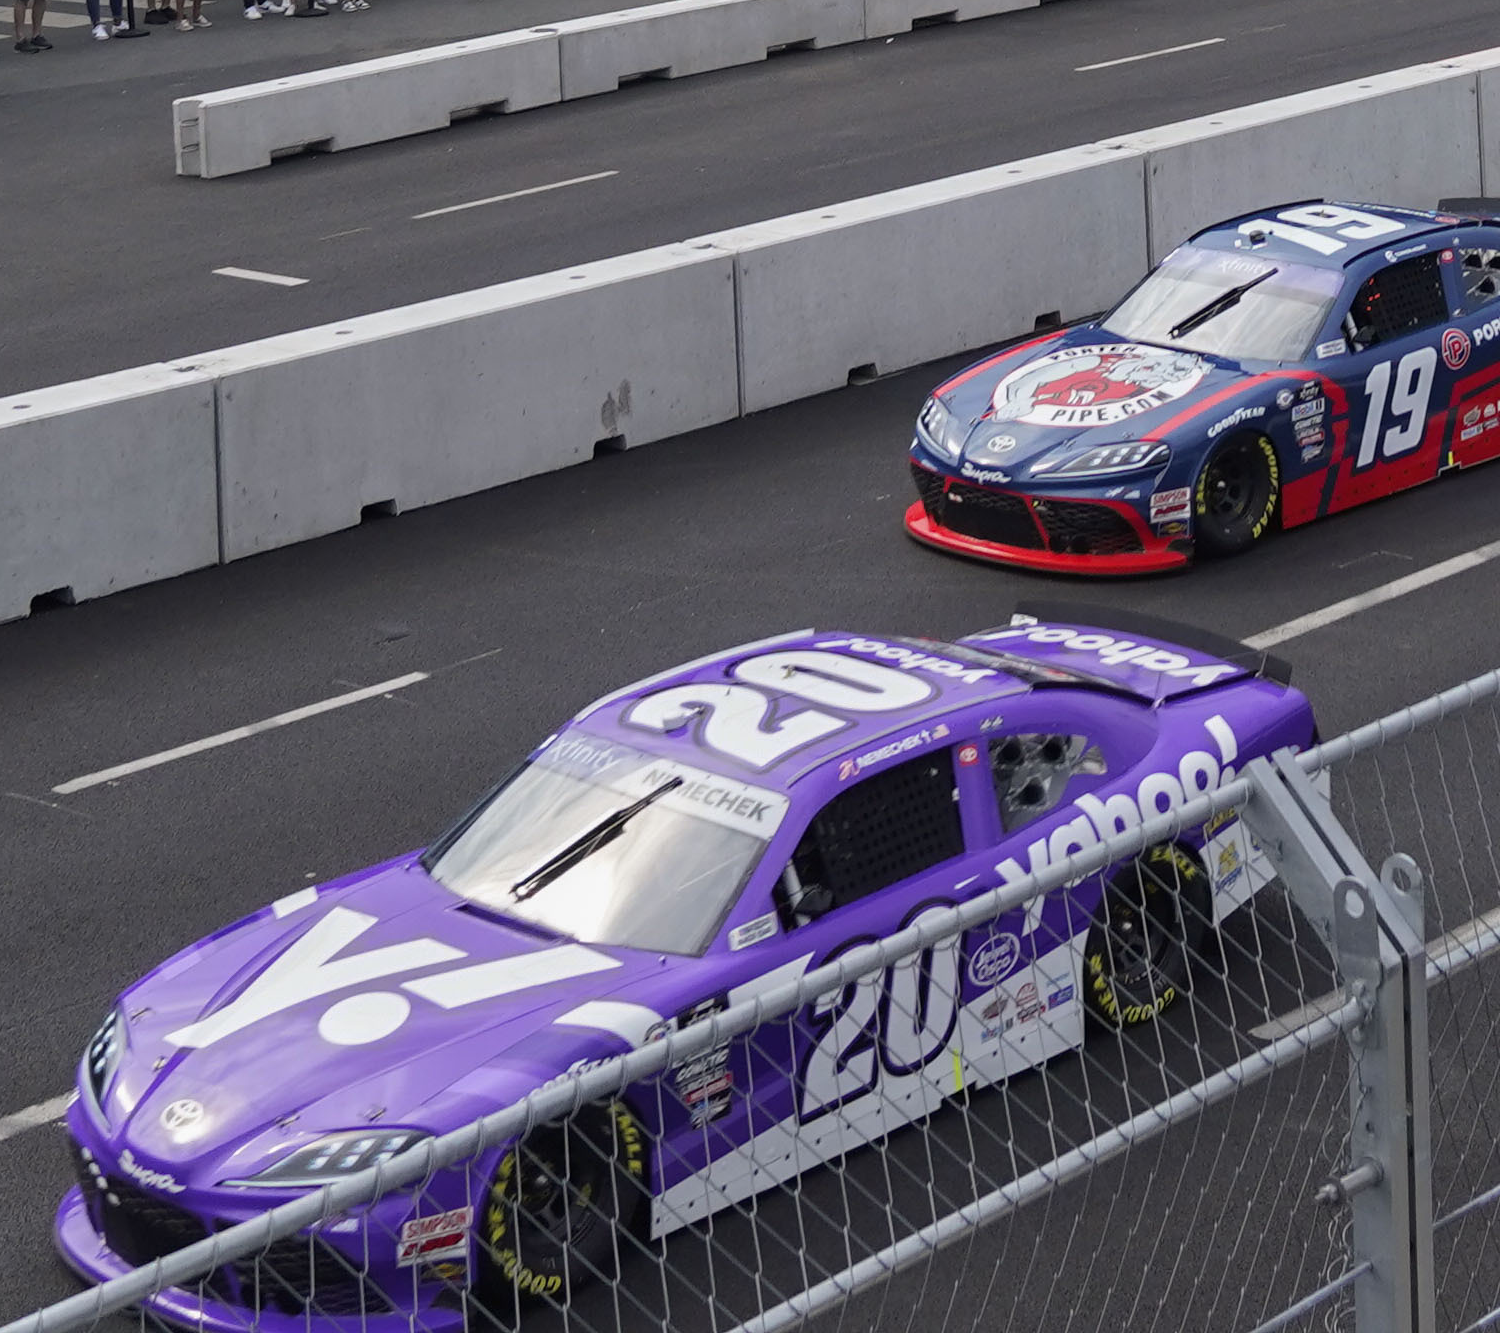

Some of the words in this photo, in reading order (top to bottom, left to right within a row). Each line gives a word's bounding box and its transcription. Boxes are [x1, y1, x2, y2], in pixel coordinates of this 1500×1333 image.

[1237, 204, 1406, 256] 19
[1050, 345, 1138, 360] PORTER
[1050, 390, 1174, 422] PIPE.COM
[1207, 406, 1266, 438] GOODYEAR
[1356, 345, 1438, 469] 19
[961, 461, 1013, 484] Supra
[1153, 487, 1188, 506] SIMPSON
[813, 636, 999, 685] yahoo!
[622, 649, 938, 769] 20
[550, 736, 618, 770] xfinity
[642, 769, 772, 823] NMECHEK
[994, 714, 1238, 937] yahoo!
[800, 901, 964, 1120] 20
[405, 1211, 467, 1238] SIMPSON
